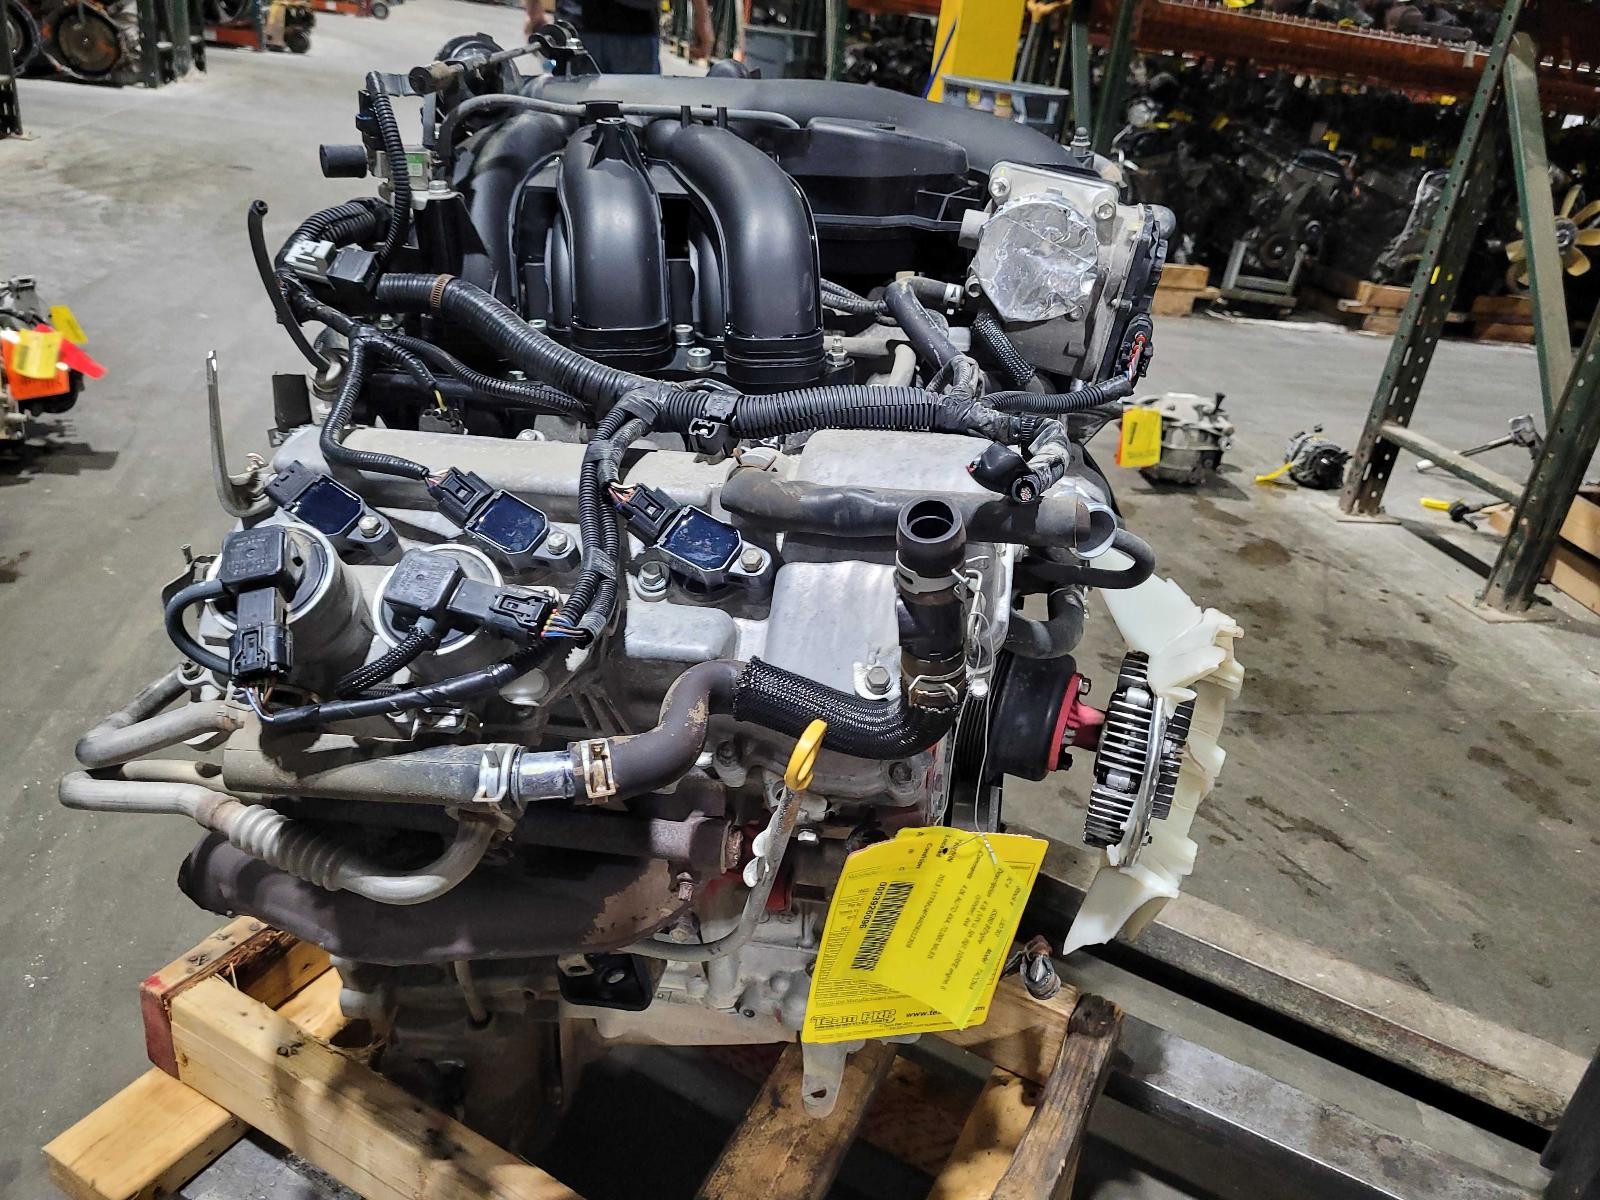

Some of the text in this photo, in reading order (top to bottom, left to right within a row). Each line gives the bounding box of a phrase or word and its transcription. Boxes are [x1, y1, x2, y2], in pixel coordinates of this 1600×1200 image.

[916, 842, 933, 869] Condition
[859, 881, 887, 929] 0003926096
[811, 1015, 858, 1029] Team
